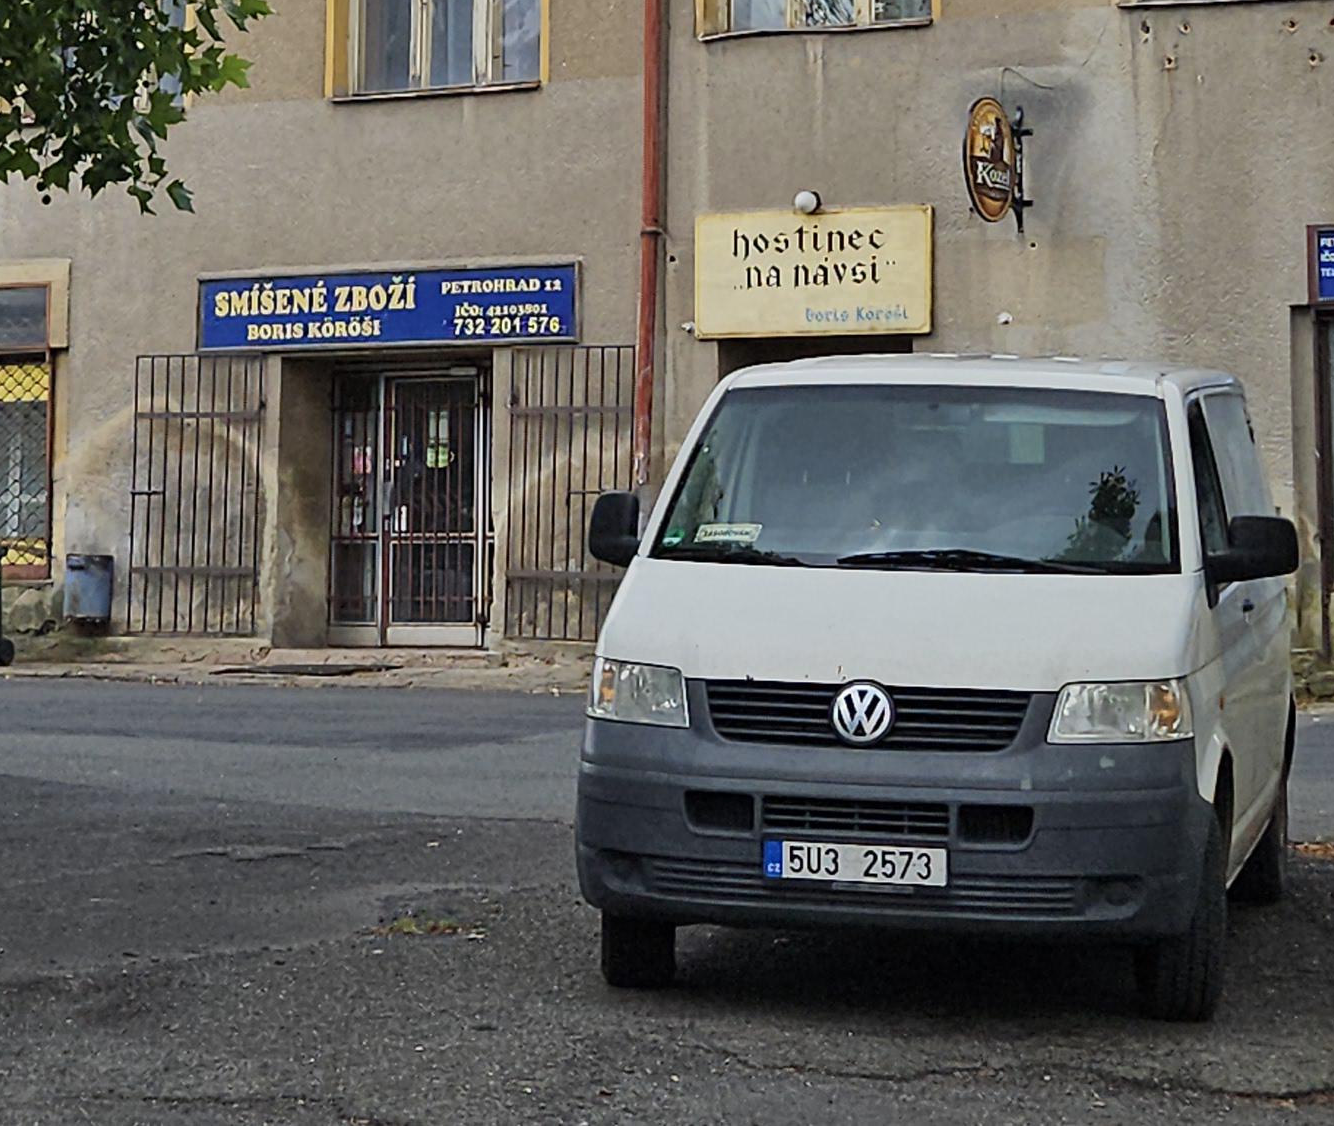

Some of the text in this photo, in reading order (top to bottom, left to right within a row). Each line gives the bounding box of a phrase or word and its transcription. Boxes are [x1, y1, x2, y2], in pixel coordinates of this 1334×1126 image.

[732, 224, 886, 261] hostinec
[215, 275, 416, 317] SMÍŠENÉ ZBOŽÍ
[441, 278, 562, 294] PETROHRAD 12
[247, 315, 382, 341] BORIS KÖRÖŠI
[453, 315, 561, 335] 732 201 576
[767, 863, 781, 873] CZ
[789, 846, 932, 880] 5U3 2573
